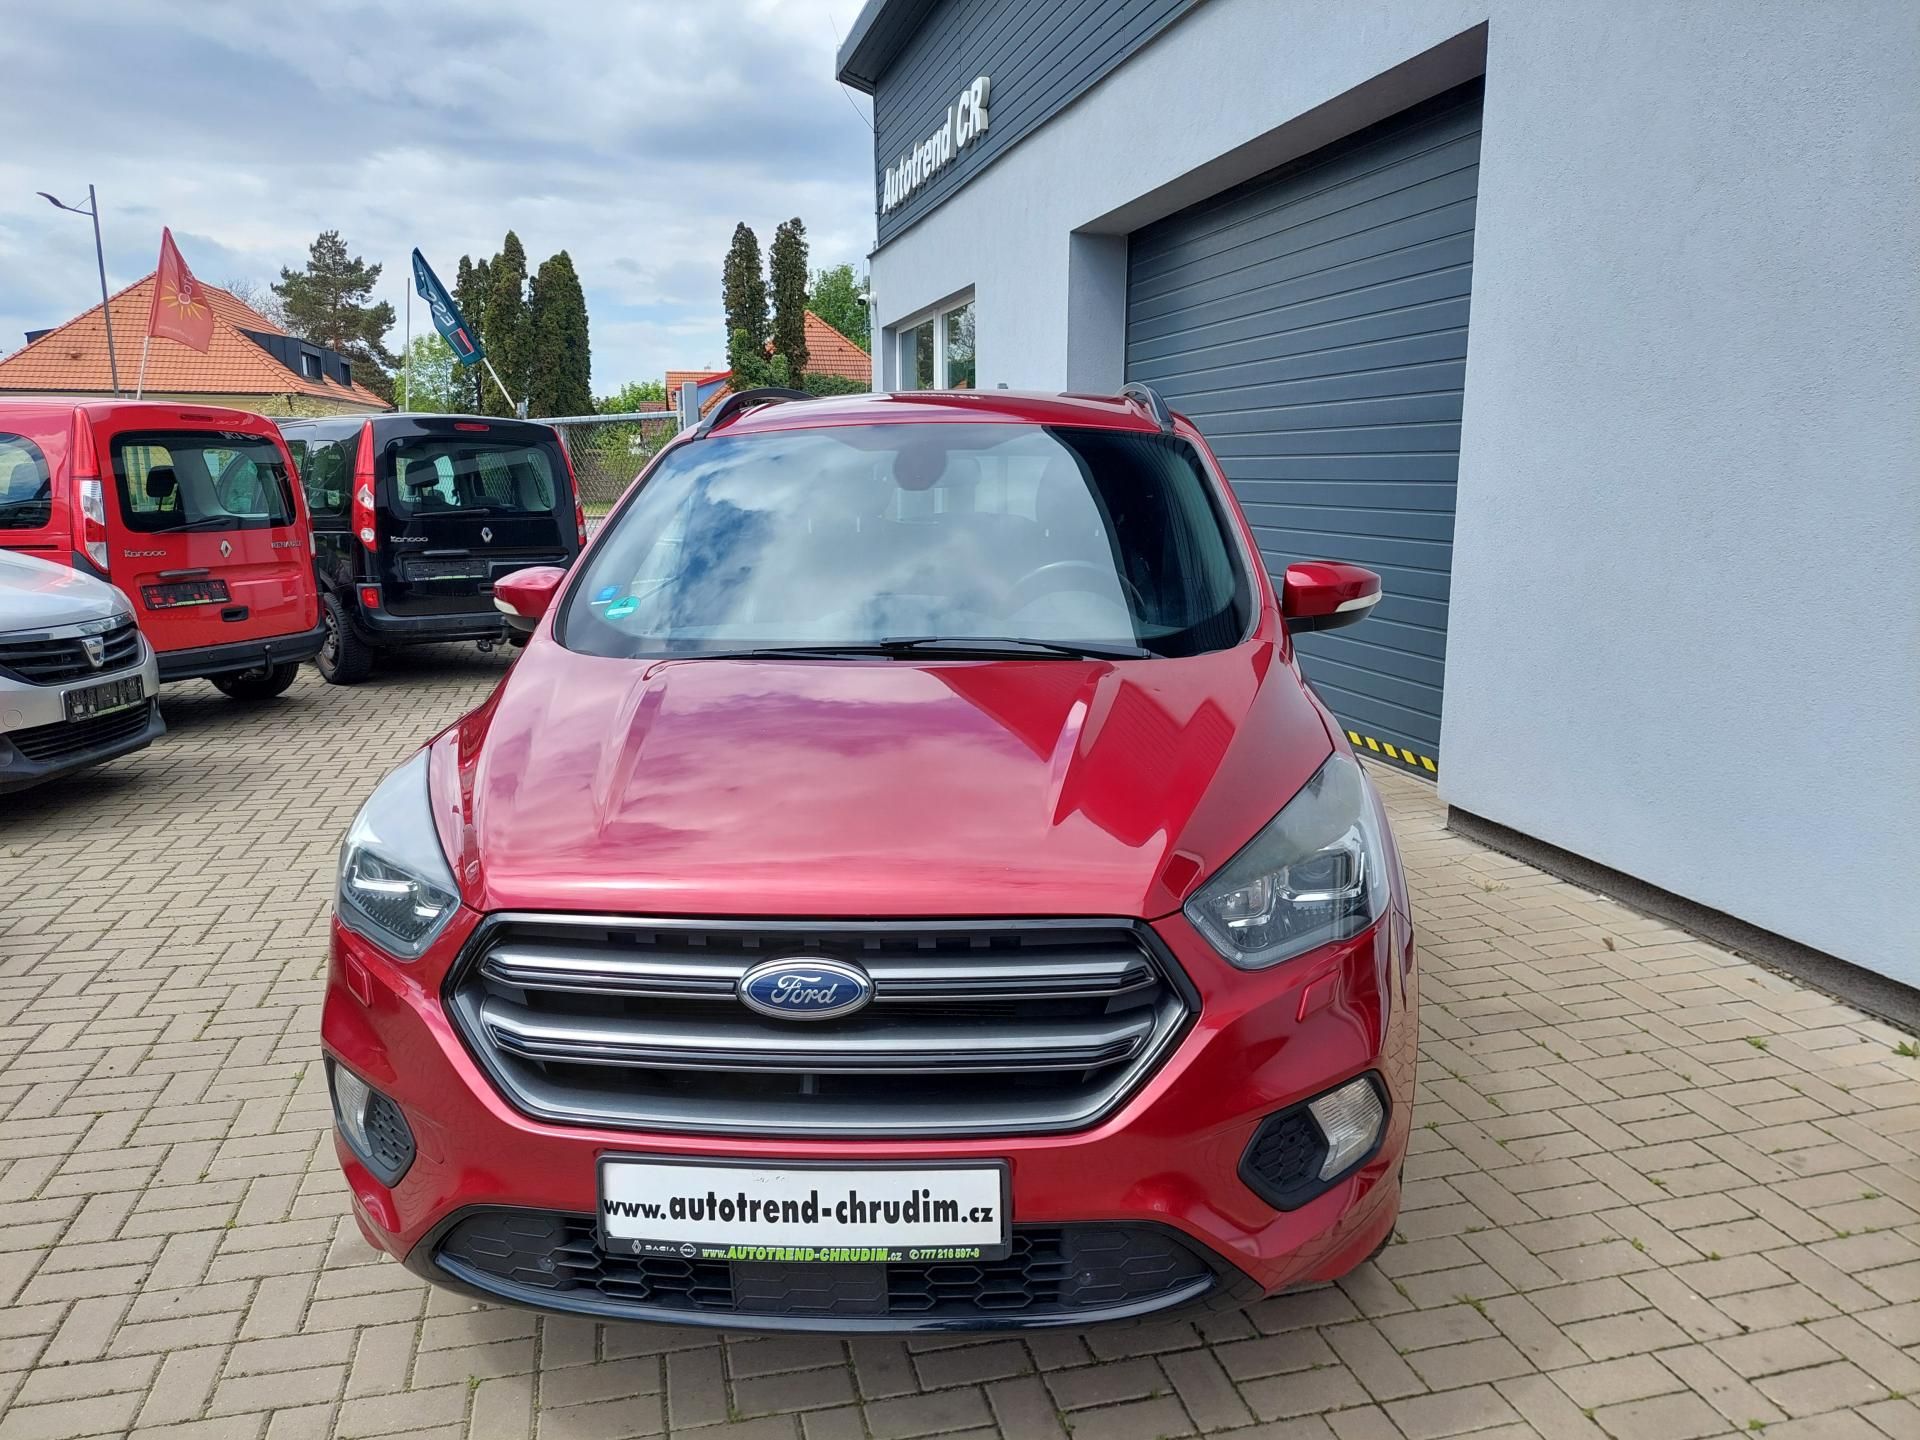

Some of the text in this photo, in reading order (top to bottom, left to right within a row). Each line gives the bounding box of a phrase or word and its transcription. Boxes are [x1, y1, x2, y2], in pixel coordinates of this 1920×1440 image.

[882, 76, 991, 215] Autotrend CR
[770, 974, 838, 1004] Ford
[604, 1189, 994, 1224] www.autotrend-chrudim.cz
[702, 1246, 902, 1262] www.AUTOTREND-CHRUDIM.cz
